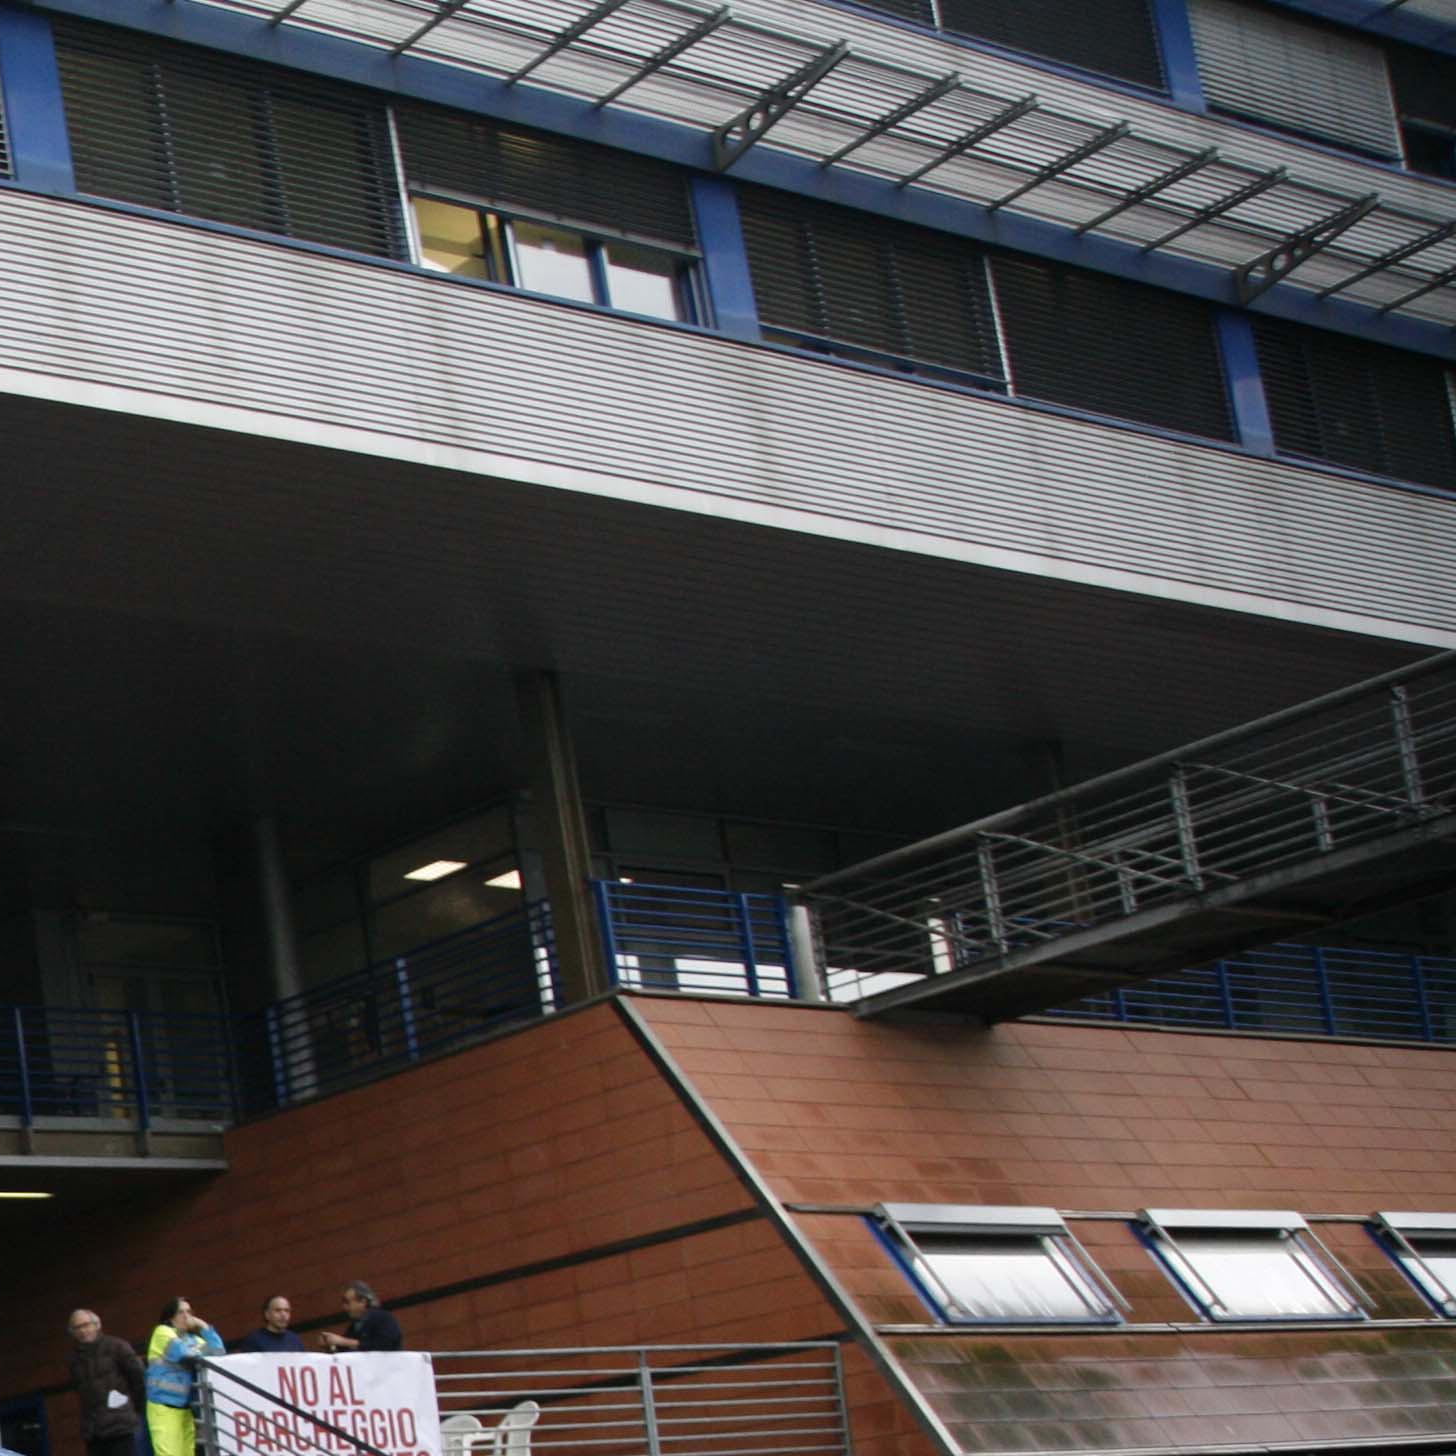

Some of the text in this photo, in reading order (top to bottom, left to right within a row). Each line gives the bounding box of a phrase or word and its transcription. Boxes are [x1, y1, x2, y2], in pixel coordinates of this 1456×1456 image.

[277, 1365, 365, 1408] NO AL
[233, 1407, 419, 1453] PARCHEGGIO
